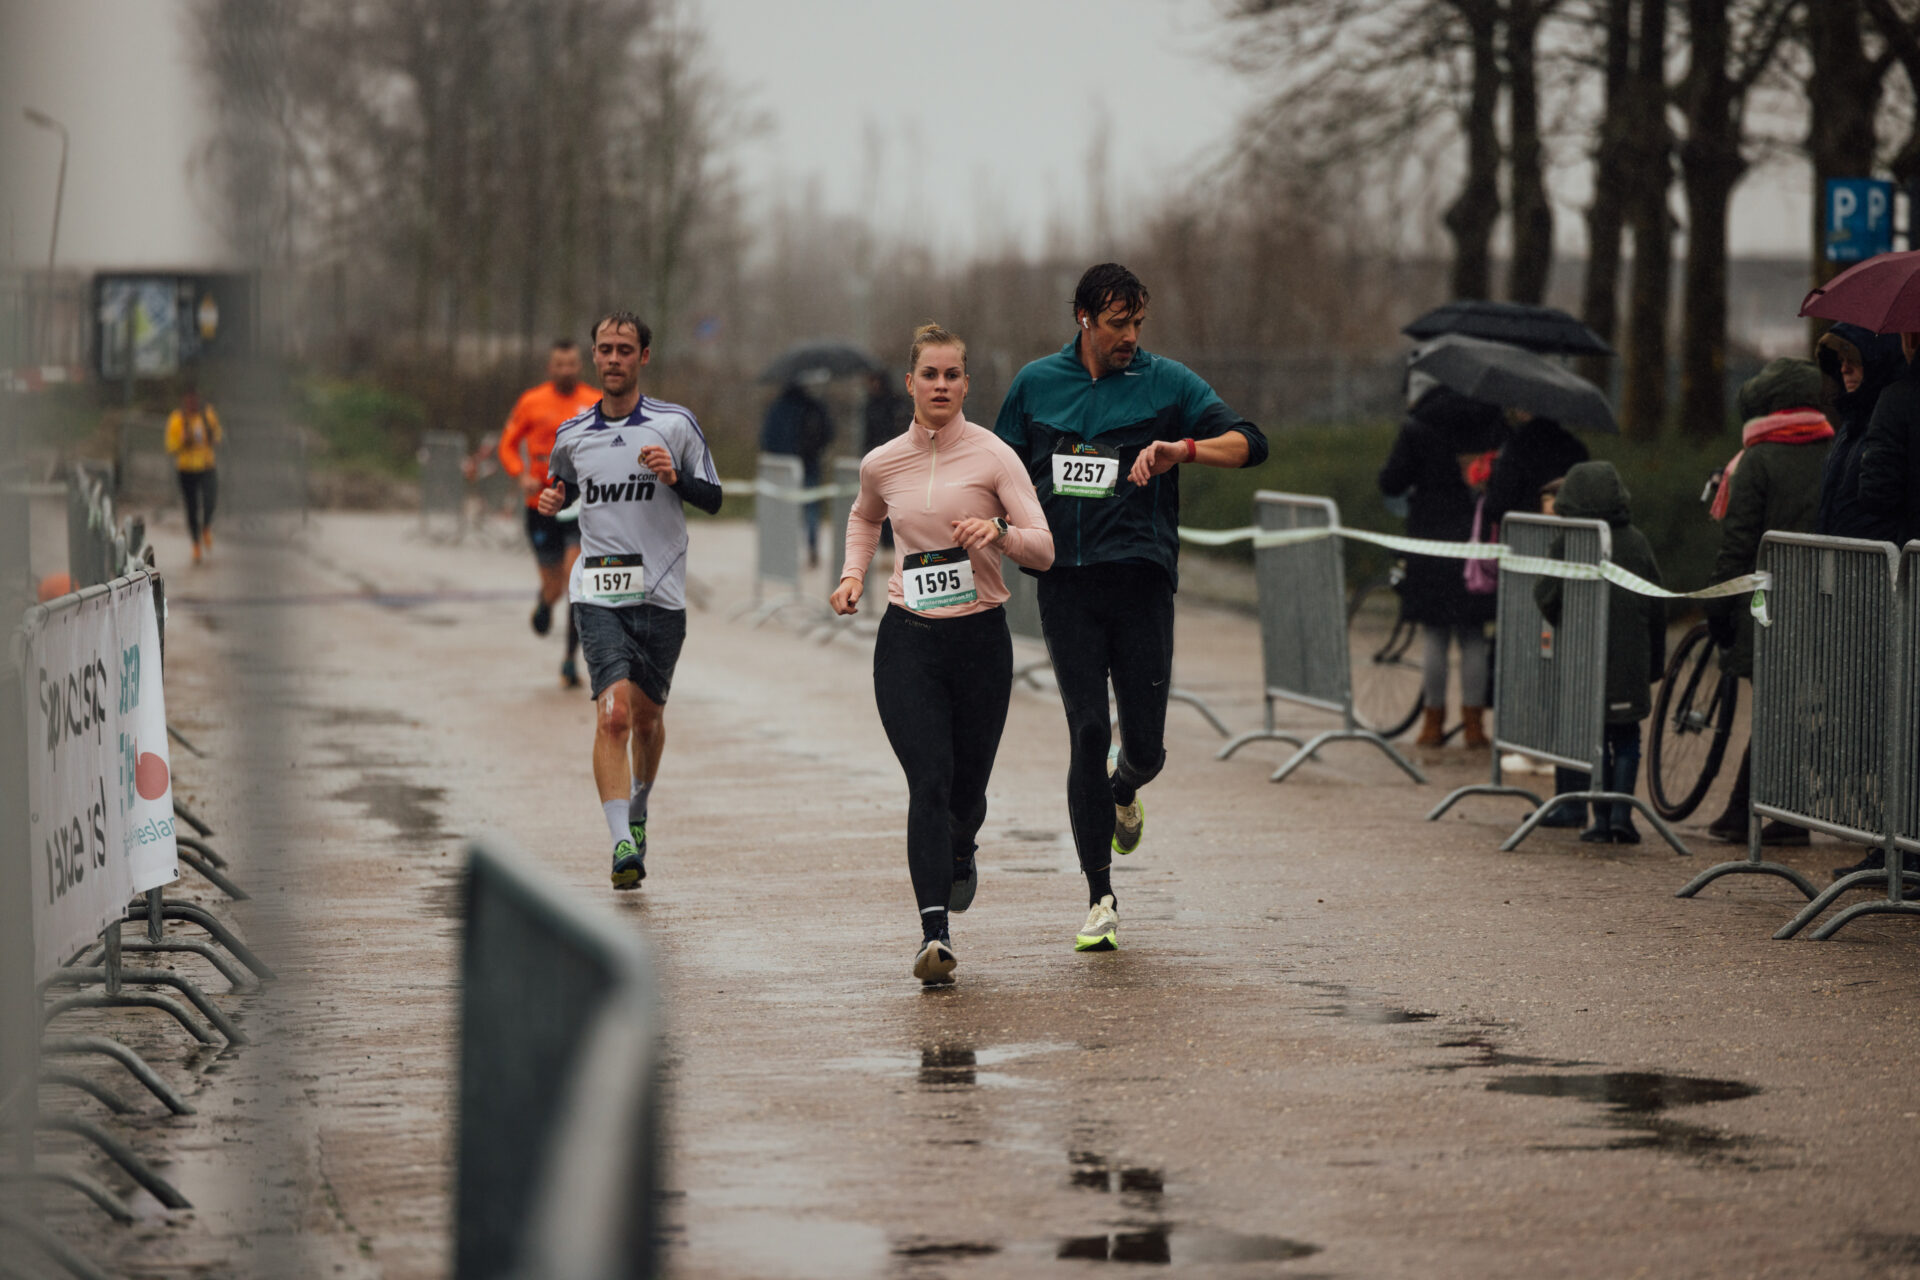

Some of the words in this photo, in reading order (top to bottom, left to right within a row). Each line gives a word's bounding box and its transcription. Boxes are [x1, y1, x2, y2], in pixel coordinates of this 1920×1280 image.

[1833, 187, 1857, 231] P
[1867, 187, 1887, 231] P
[1063, 461, 1105, 483] 2257
[586, 474, 656, 504] bwin
[594, 573, 632, 591] 1597
[915, 569, 961, 595] 1595
